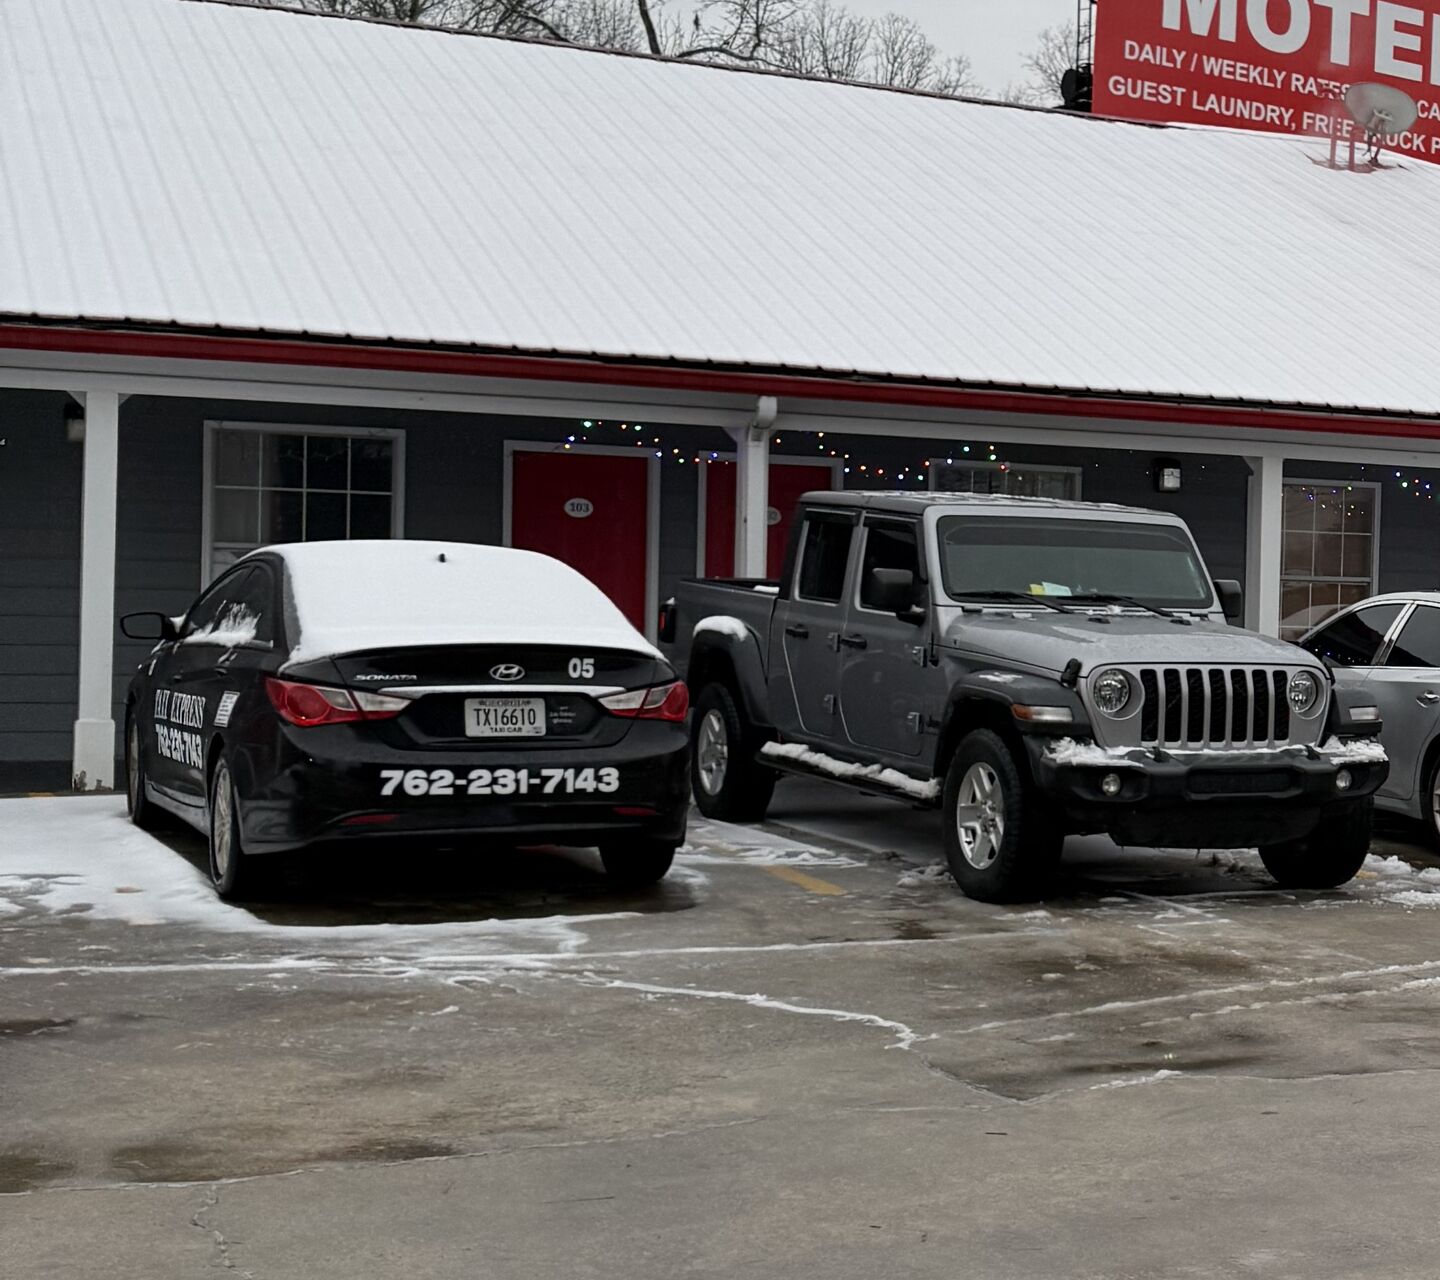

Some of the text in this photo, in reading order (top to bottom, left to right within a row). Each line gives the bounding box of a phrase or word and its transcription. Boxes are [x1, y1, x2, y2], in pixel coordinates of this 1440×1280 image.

[1124, 39, 1187, 70] DAILY
[1190, 53, 1198, 72] /
[1202, 55, 1287, 89] WEEKLY
[1108, 75, 1186, 106] GUEST
[1192, 90, 1296, 131] LAUNDRY,
[354, 673, 418, 681] SONATA
[568, 657, 595, 679] 05
[473, 708, 536, 726] TX16610
[380, 767, 620, 796] 762-231-7143
